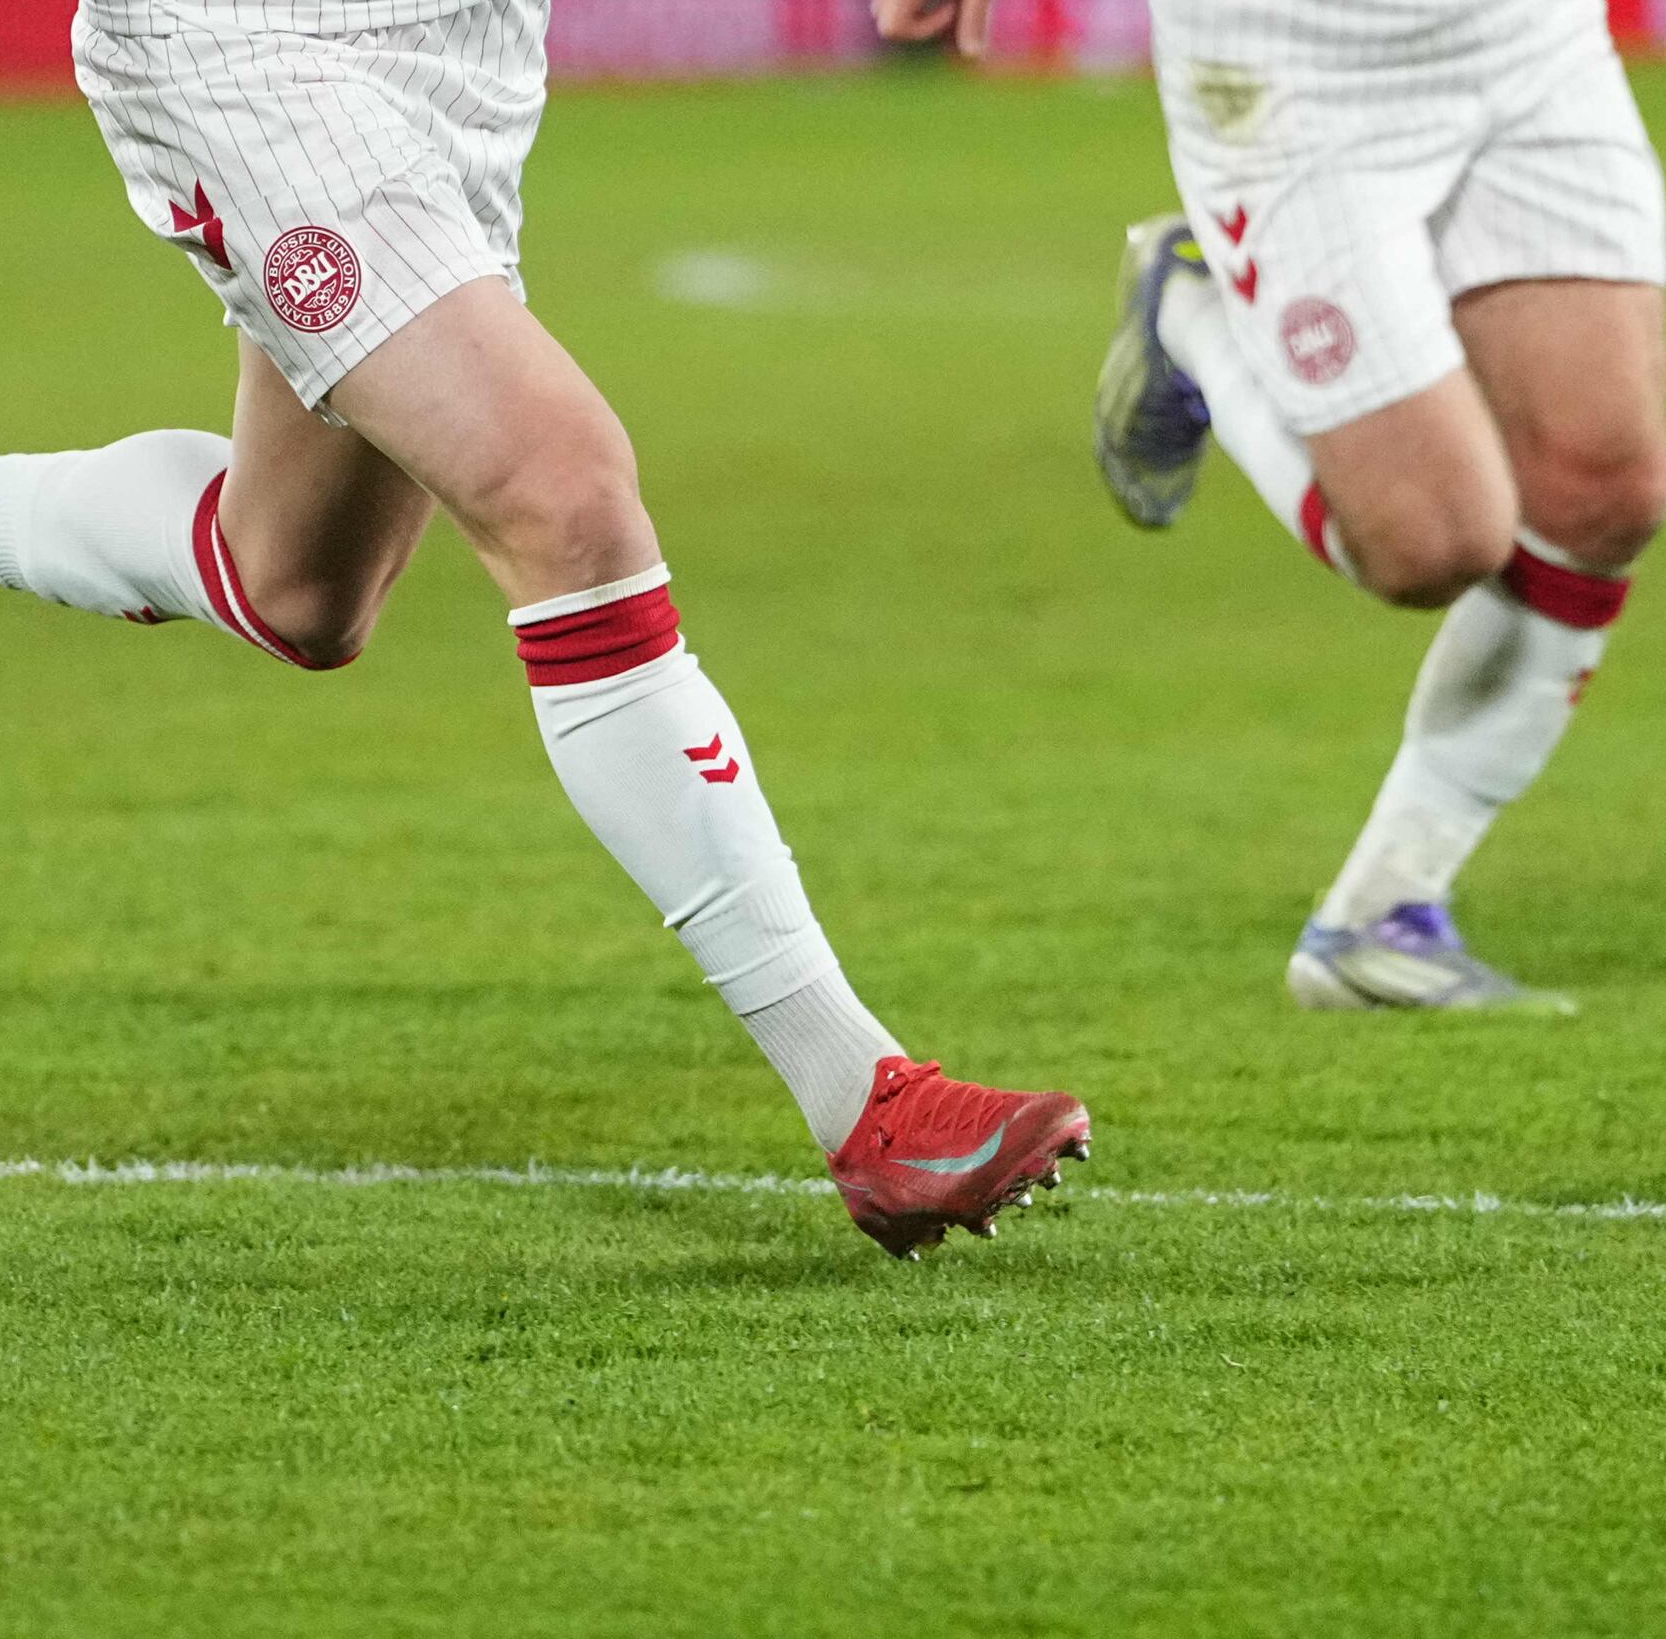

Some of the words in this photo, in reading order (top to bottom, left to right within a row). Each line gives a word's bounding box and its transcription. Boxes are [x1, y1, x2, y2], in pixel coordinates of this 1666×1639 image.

[270, 283, 311, 325] DANSK
[326, 239, 354, 288] UNION
[283, 251, 338, 305] DBU
[317, 295, 349, 325] 1889
